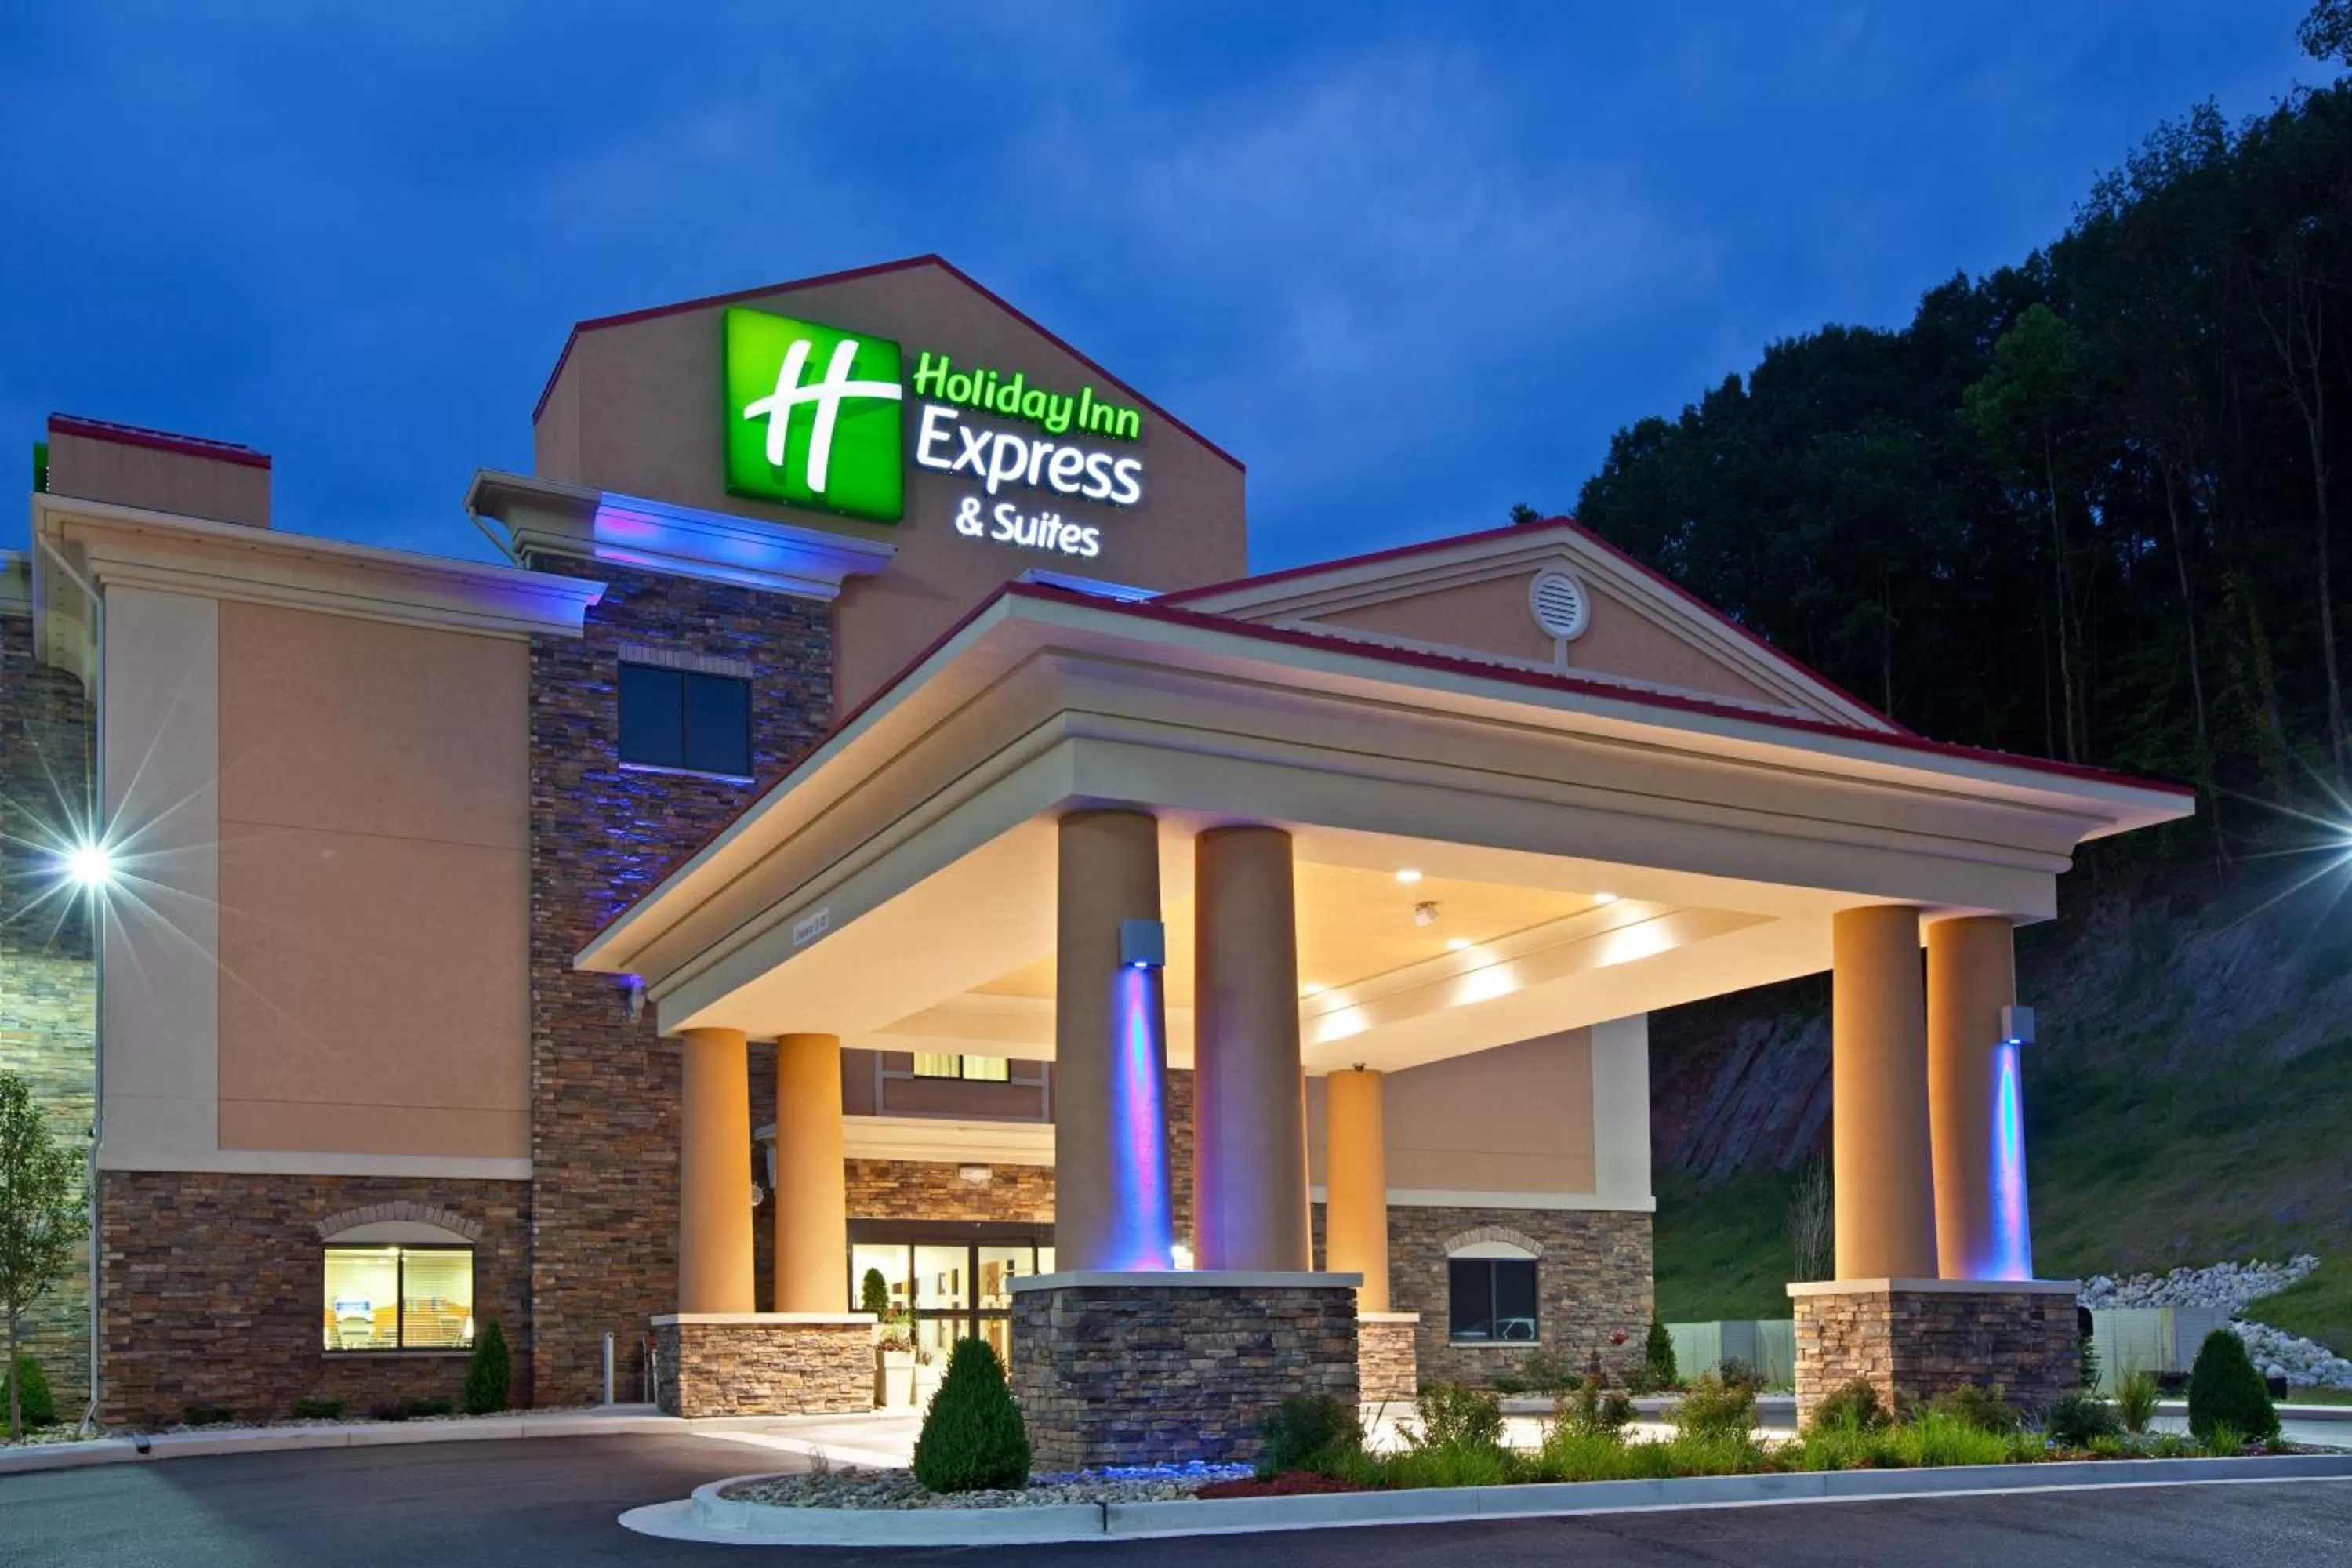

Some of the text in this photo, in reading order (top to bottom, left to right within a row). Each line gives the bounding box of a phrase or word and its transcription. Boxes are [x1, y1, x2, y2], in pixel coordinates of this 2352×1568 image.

[913, 352, 1140, 439] Holiday Inn
[916, 405, 1142, 505] Express
[956, 497, 1100, 557] & Suites
